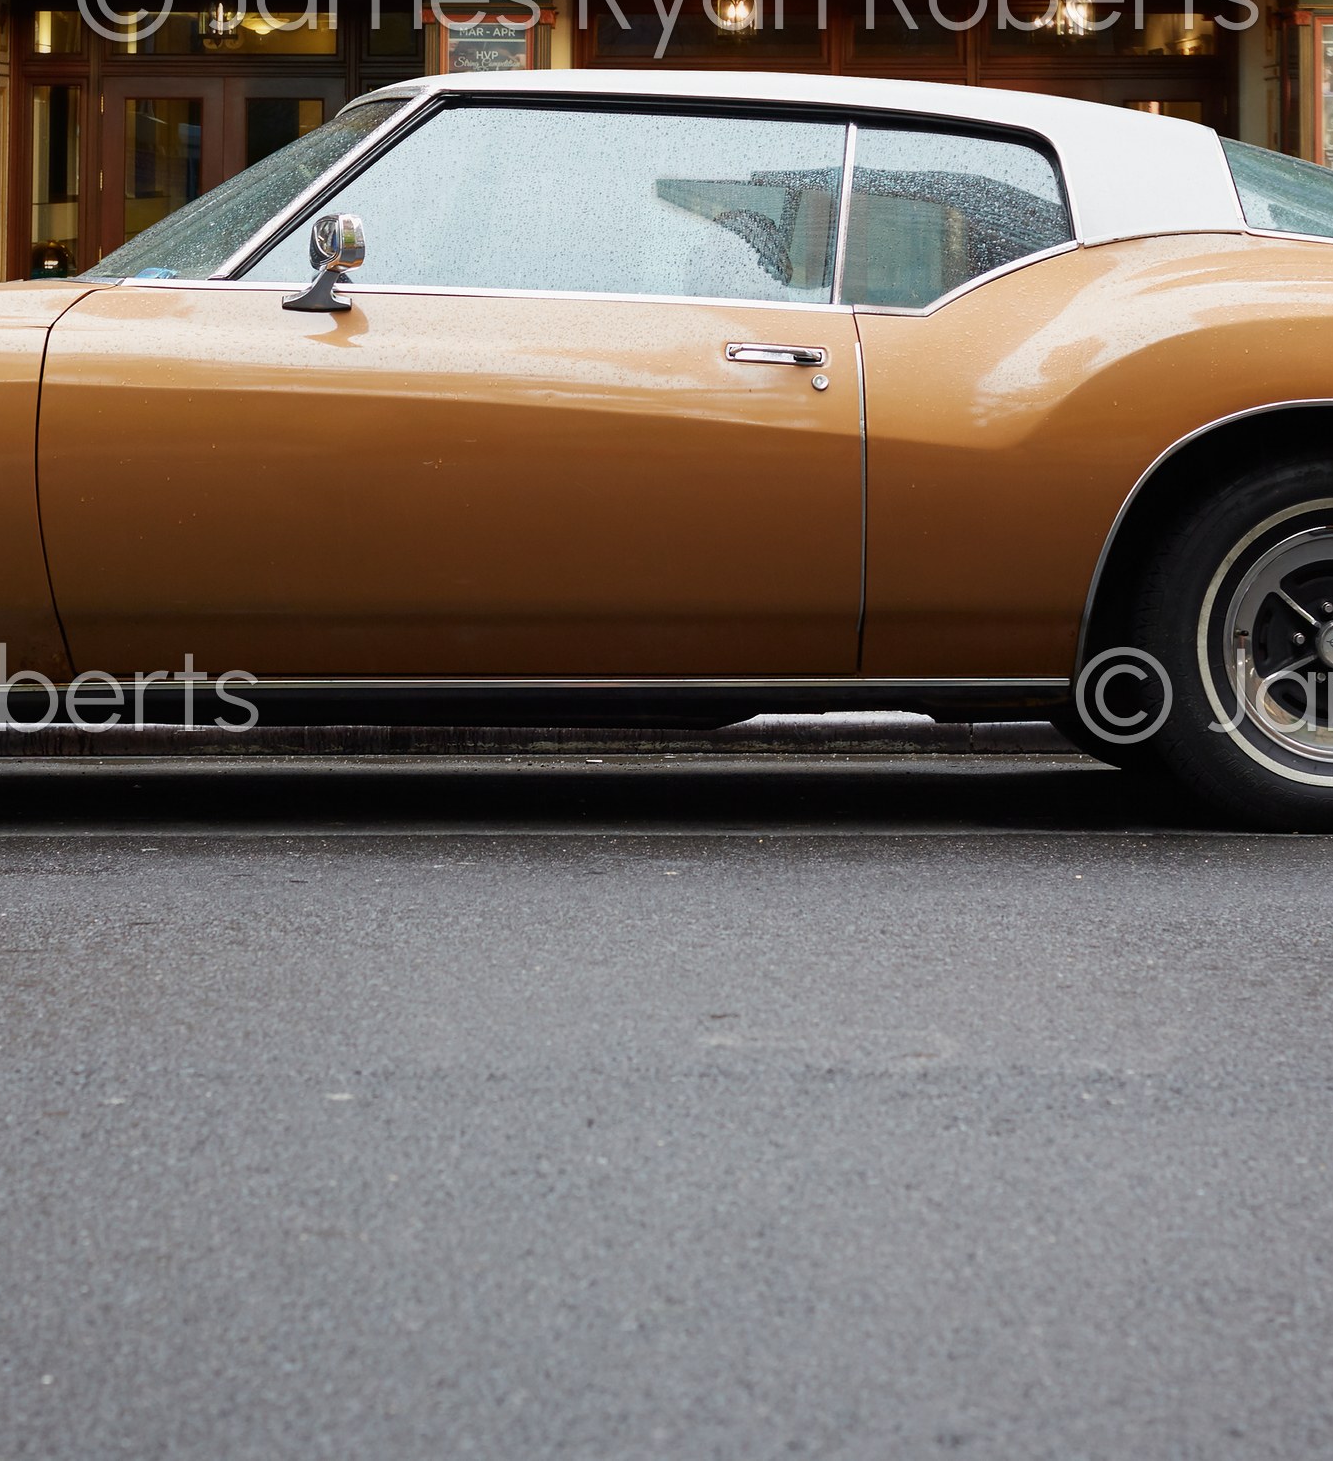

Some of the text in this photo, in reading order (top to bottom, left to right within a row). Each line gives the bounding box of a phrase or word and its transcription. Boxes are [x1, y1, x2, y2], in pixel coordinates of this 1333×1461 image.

[459, 26, 484, 37] MAR
[493, 26, 516, 37] APR
[475, 50, 499, 60] HVP
